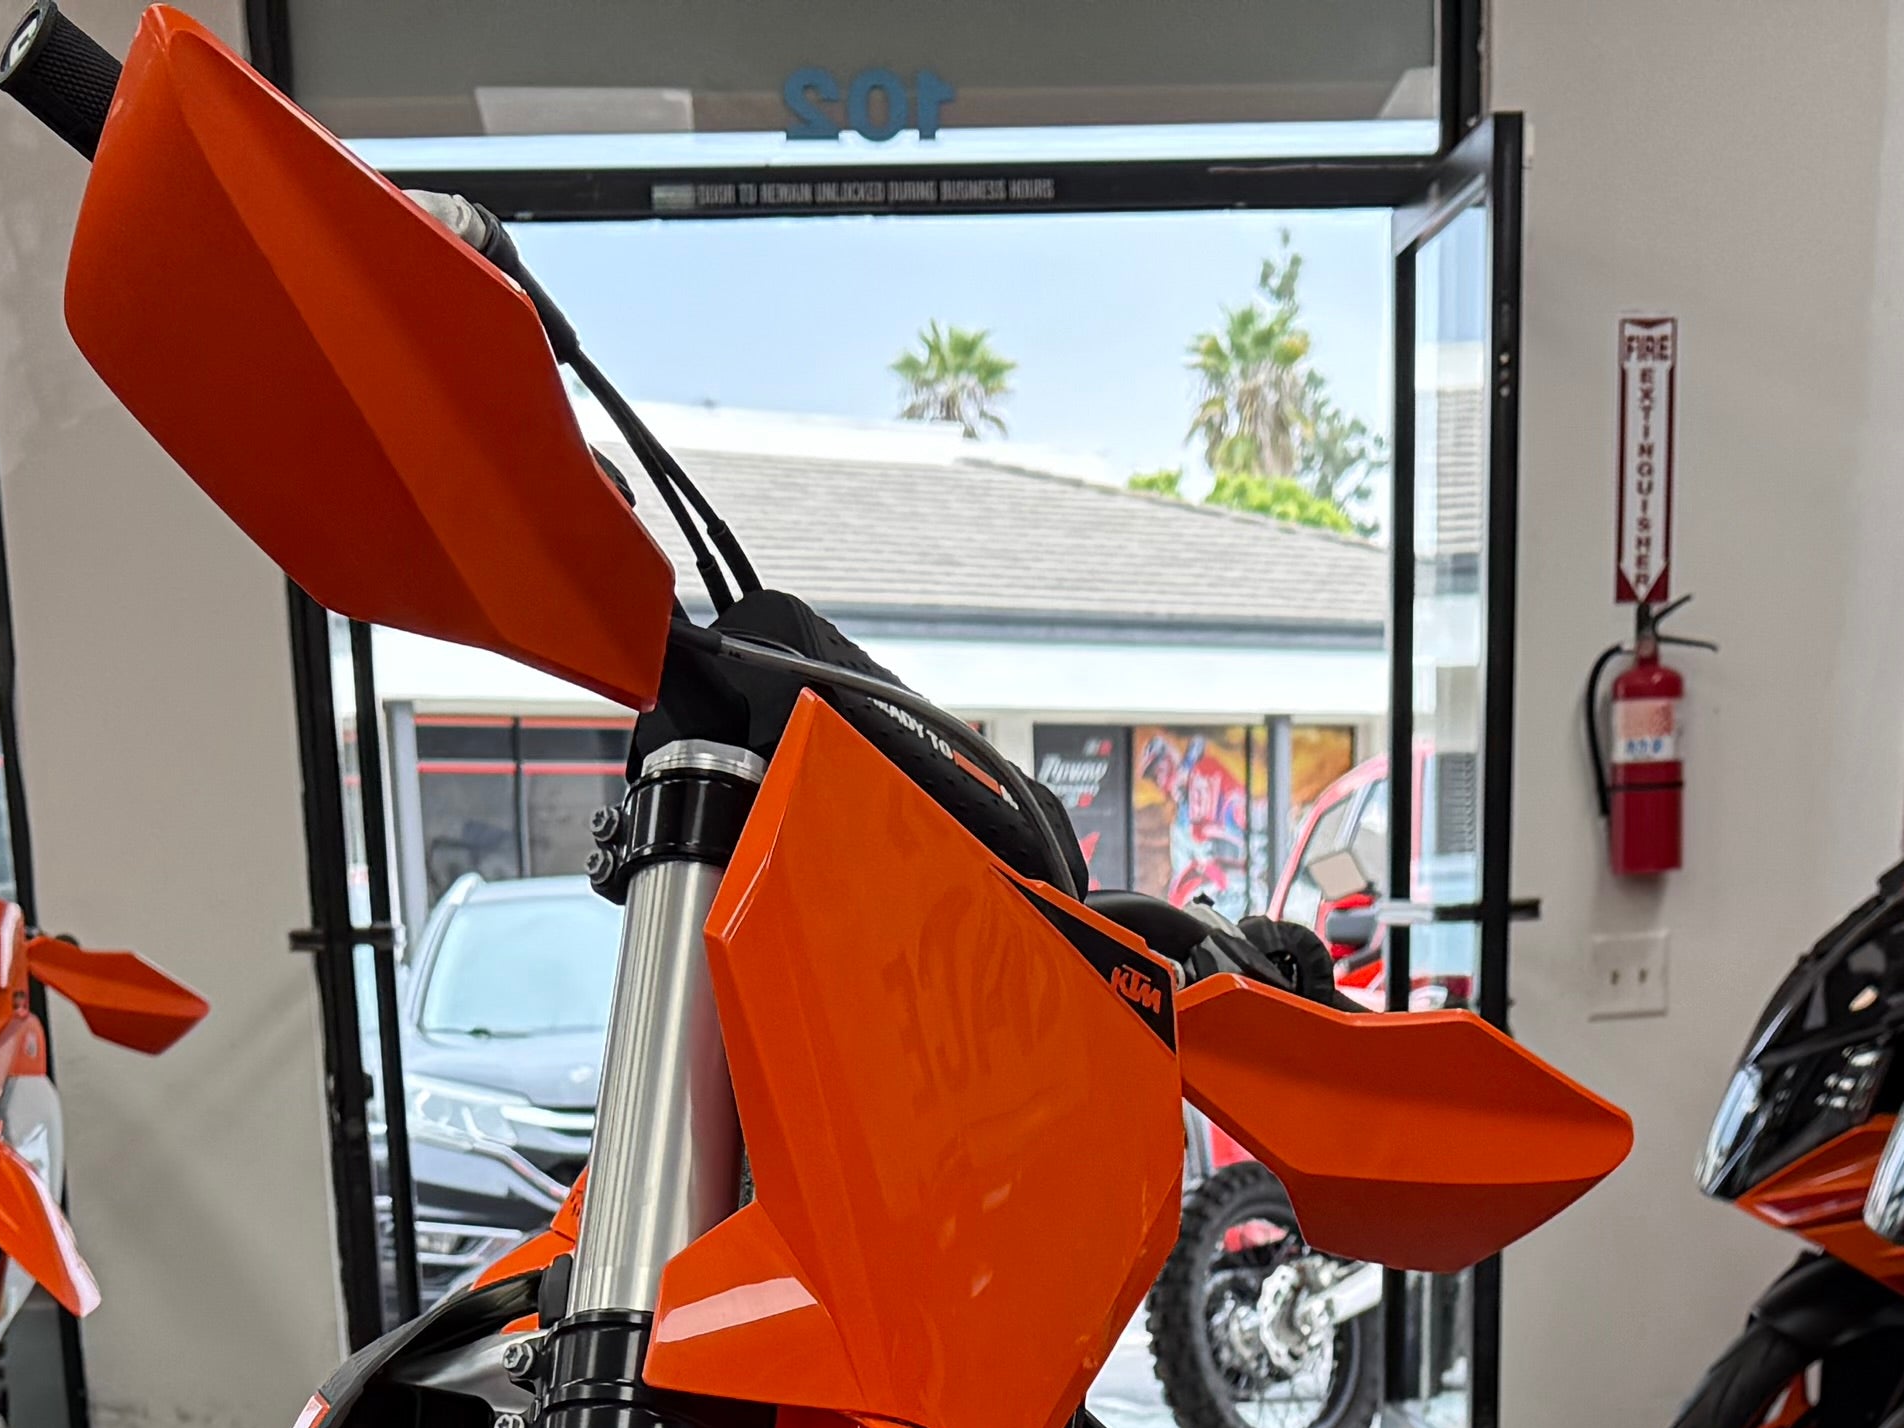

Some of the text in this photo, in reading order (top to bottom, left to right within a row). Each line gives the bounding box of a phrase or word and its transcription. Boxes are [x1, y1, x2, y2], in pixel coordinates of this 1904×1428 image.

[738, 183, 757, 204] TO
[759, 183, 813, 204] REMAIN
[814, 182, 886, 203] UNLOCKED
[887, 181, 938, 202] DURING
[939, 179, 1008, 201] BUSINESS
[1008, 178, 1056, 199] HOURS
[1625, 334, 1670, 362] FIRE
[1634, 367, 1655, 586] EXTINGUISHER
[926, 729, 954, 760] TO
[1110, 963, 1162, 1014] KTM
